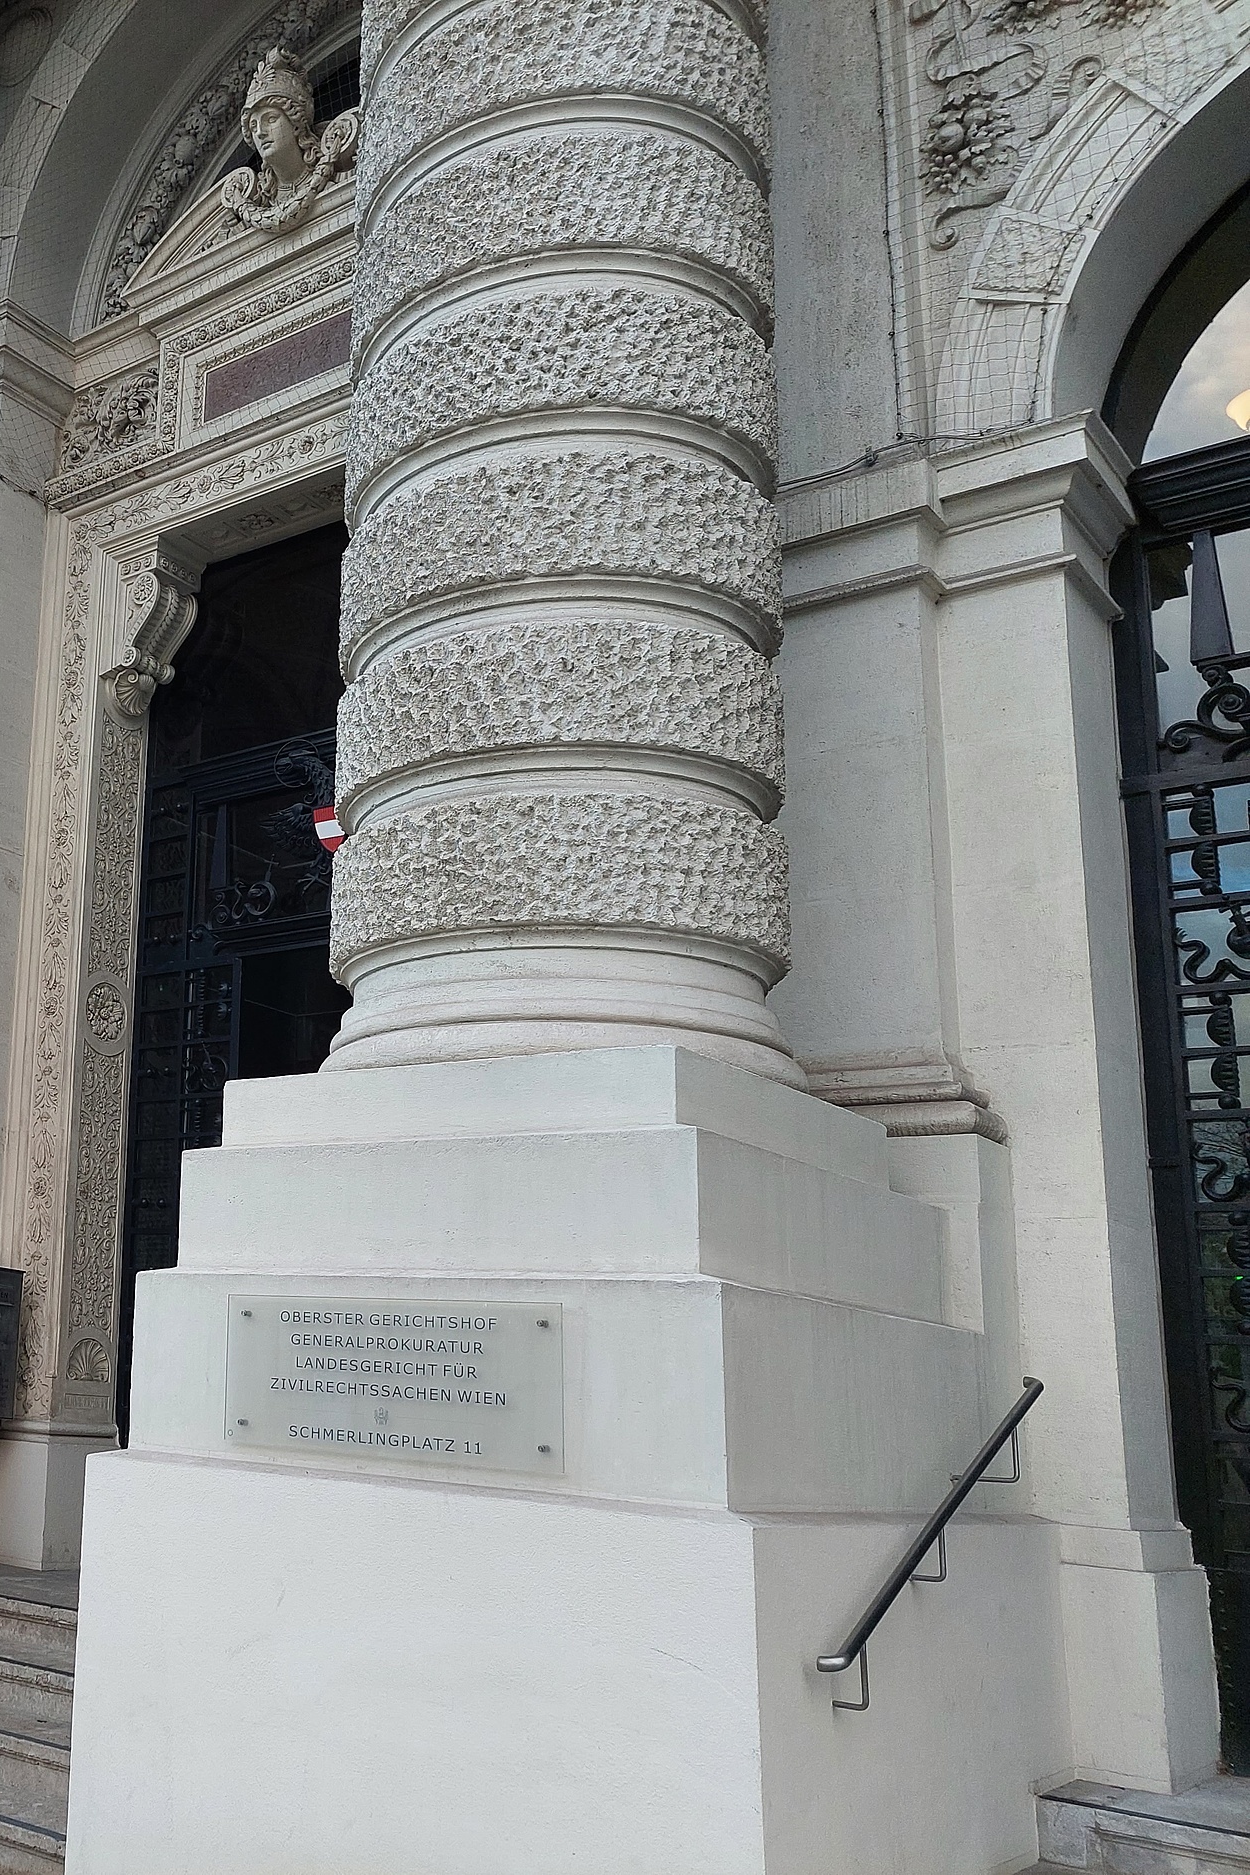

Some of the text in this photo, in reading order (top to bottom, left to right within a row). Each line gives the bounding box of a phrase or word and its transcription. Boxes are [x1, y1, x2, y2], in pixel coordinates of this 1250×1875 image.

[280, 1311, 497, 1330] OBERSTER GERICHTSHOF
[290, 1334, 484, 1355] GENERALPROKURATUR
[295, 1356, 478, 1379] LANDESGERICHT FÜR
[270, 1377, 507, 1406] ZIVILRECHTSSACHEN WIEN
[289, 1425, 483, 1455] SCHMERLINGPLATZ 11
